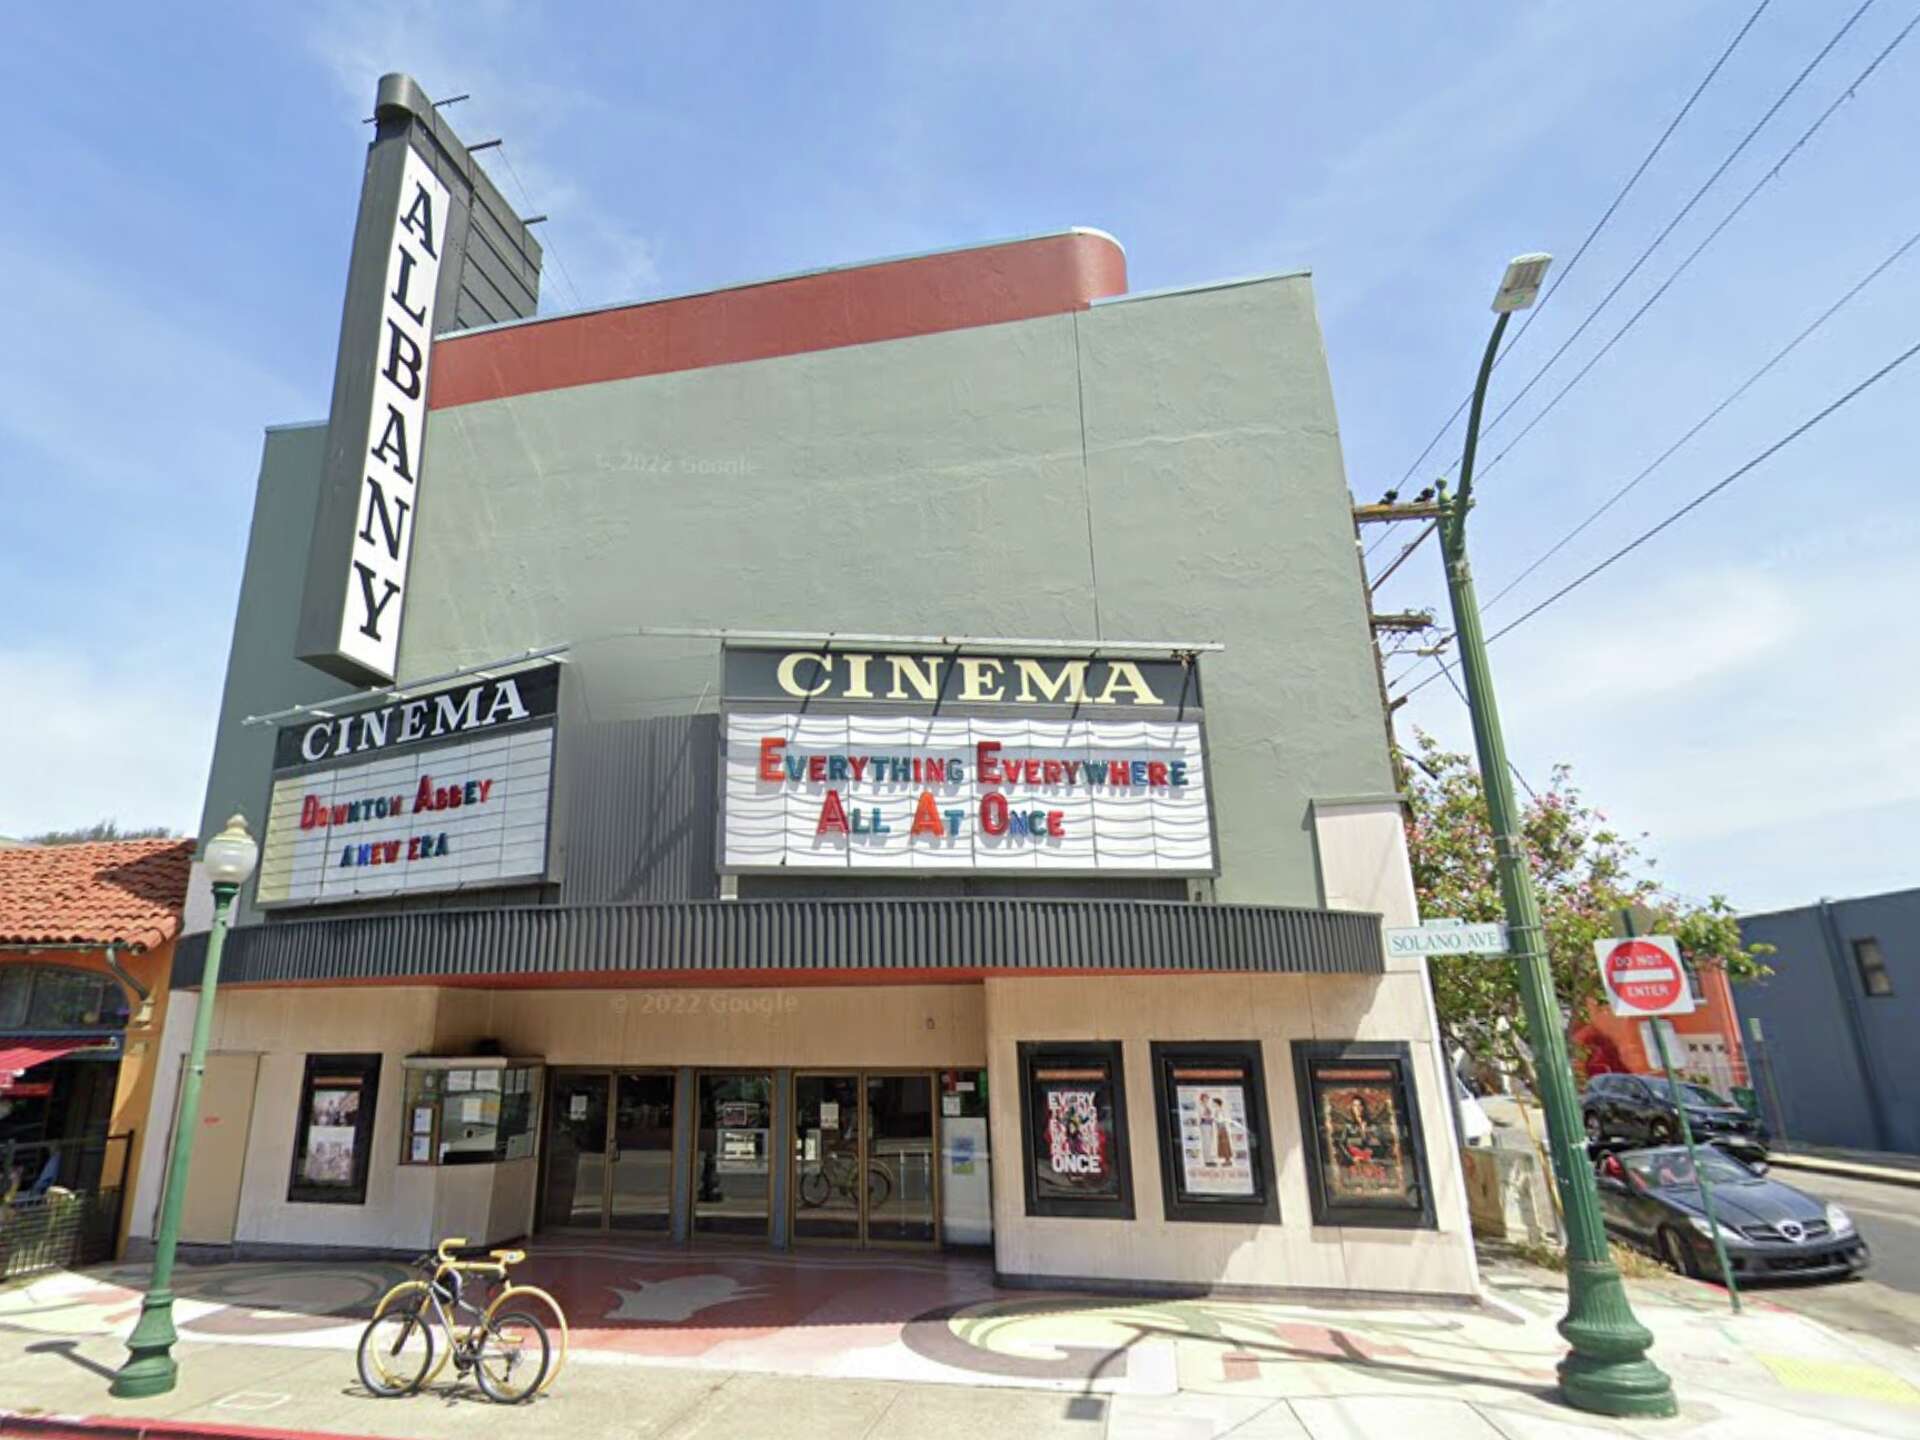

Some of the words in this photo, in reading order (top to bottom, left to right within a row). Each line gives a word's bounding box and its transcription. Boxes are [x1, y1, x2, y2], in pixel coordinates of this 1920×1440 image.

[354, 180, 438, 642] ALBANY
[775, 651, 1164, 705] CINEMA
[301, 679, 530, 762] CINEMA
[759, 737, 965, 784] EVERYTHING
[976, 741, 1189, 787] EVERYWHERE
[412, 775, 493, 814] ABBEY
[816, 789, 891, 835] ALL
[910, 790, 965, 836] AT
[978, 791, 1065, 837] ONCE
[357, 839, 402, 866] NEW
[407, 833, 449, 862] ERA
[1391, 933, 1461, 952] SOLANO
[1052, 1154, 1102, 1173] ONCE
